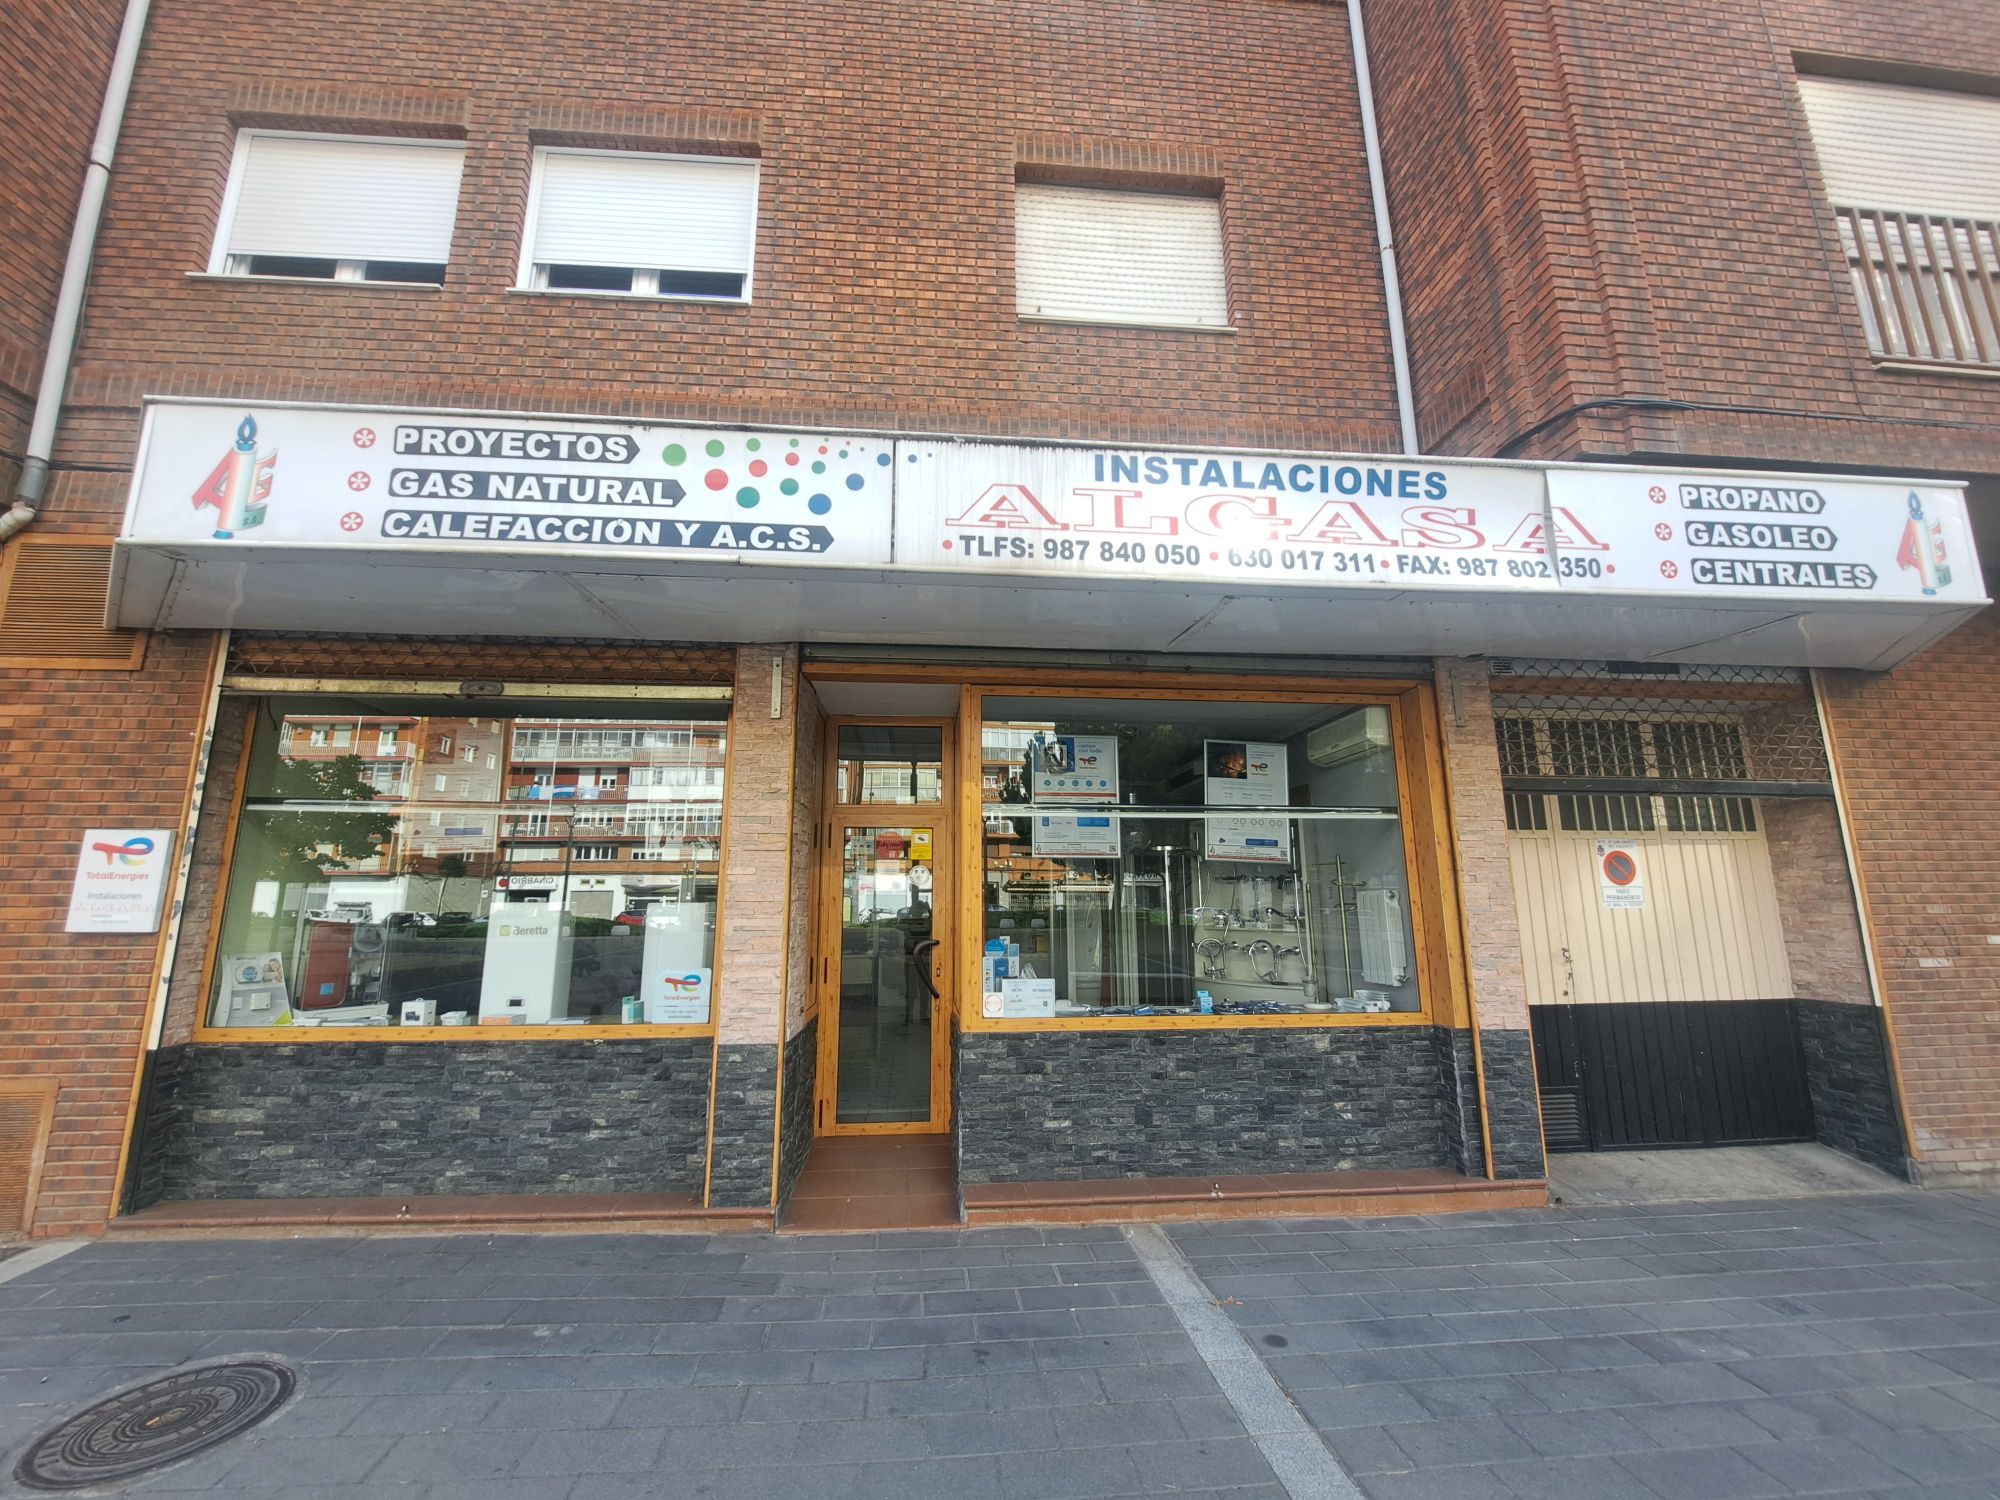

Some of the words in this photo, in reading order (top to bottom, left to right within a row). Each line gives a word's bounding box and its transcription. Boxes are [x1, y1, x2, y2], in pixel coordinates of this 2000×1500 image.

[395, 427, 629, 462] PROYECTOS
[392, 471, 474, 498] GAS
[487, 474, 674, 506] NATURAL
[1094, 454, 1448, 501] INSTALACIONES
[1681, 486, 1821, 514] PROPANO
[945, 483, 1610, 555] ALGASA
[674, 522, 701, 546] Y
[711, 524, 822, 552] A.C.S.
[1687, 523, 1832, 550] GASOLEO
[959, 535, 1035, 559] TLFS:
[1043, 538, 1090, 561] 987
[1099, 541, 1146, 564] 840
[1155, 543, 1201, 566] 050
[1228, 547, 1273, 568] 630
[1281, 549, 1324, 571] 017
[1333, 552, 1376, 573] 311
[1397, 554, 1450, 575] FAX:
[1457, 557, 1498, 577] 987
[1506, 559, 1552, 578] 802
[1560, 557, 1601, 579] 350
[1693, 561, 1873, 588] CENTRALES
[86, 872, 150, 881] TotalEnergies
[87, 892, 142, 900] Instalaciones
